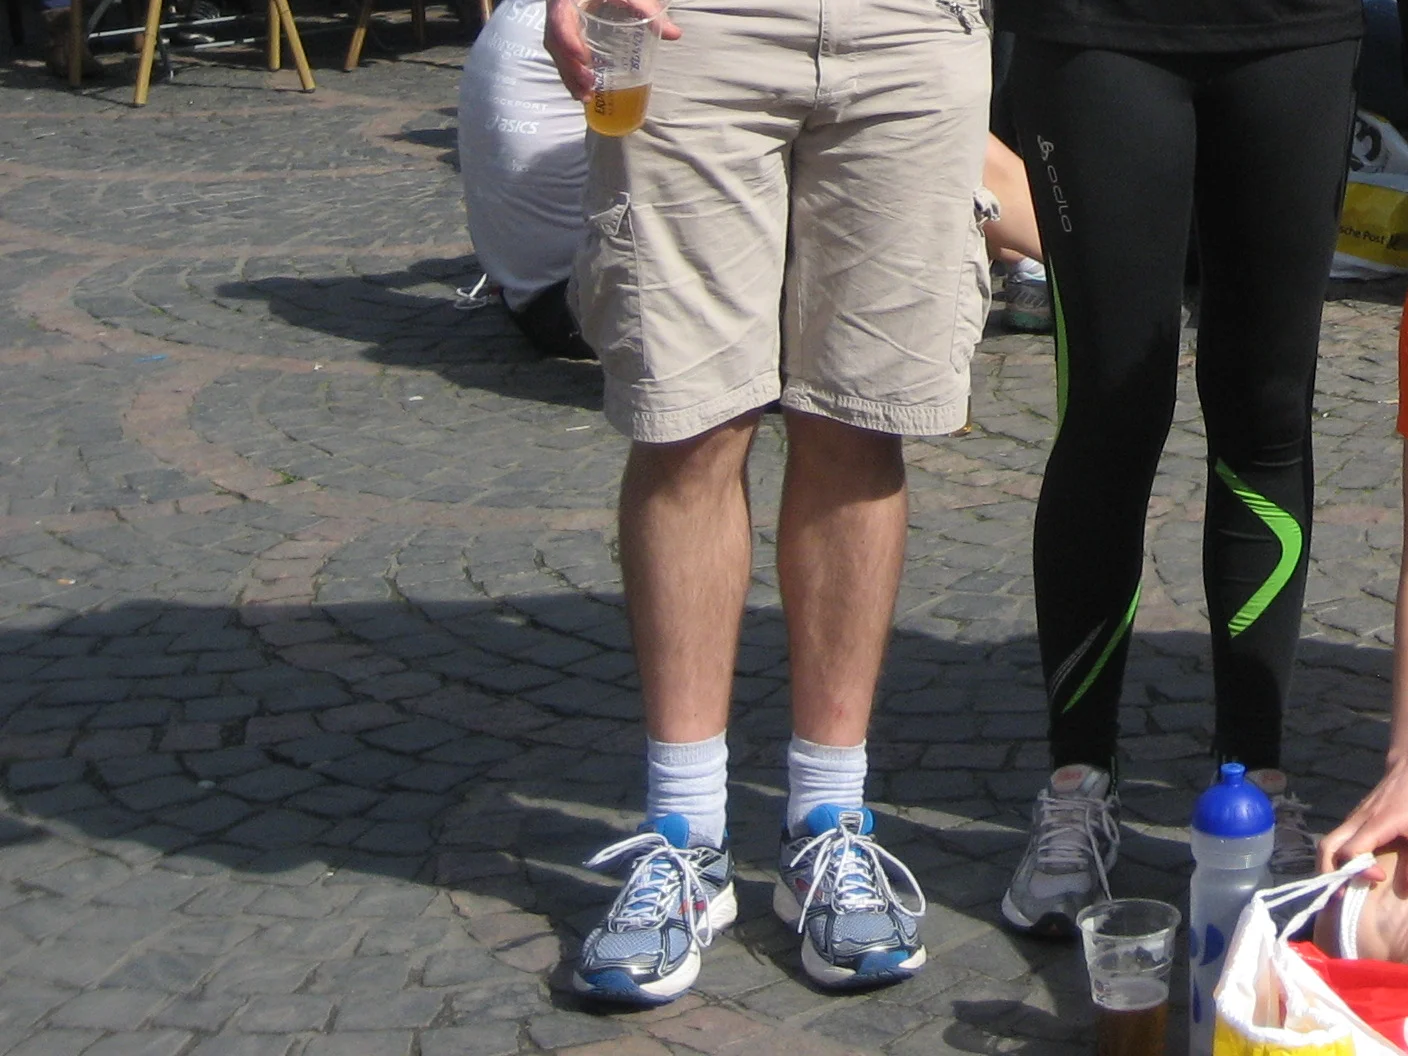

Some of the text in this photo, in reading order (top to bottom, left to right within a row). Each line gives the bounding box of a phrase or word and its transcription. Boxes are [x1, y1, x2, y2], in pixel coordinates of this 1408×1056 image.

[492, 96, 549, 112] OCKPORT
[1047, 165, 1073, 232] odlo
[1362, 231, 1386, 245] Post
